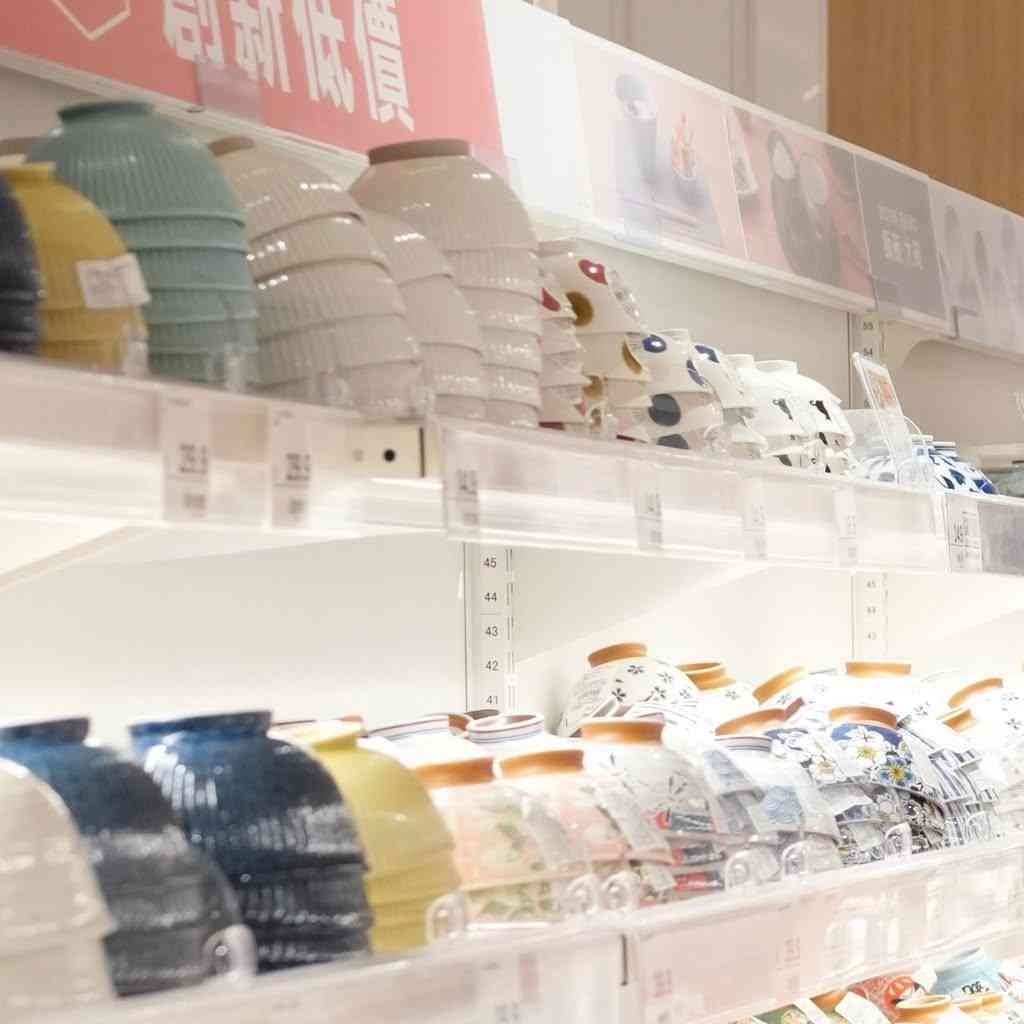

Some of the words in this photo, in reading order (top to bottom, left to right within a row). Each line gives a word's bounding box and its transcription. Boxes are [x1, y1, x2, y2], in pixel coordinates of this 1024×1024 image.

[483, 557, 497, 568] 45
[484, 592, 498, 602] 44
[485, 626, 499, 637] 43
[486, 660, 499, 671] 42
[486, 695, 499, 704] 41
